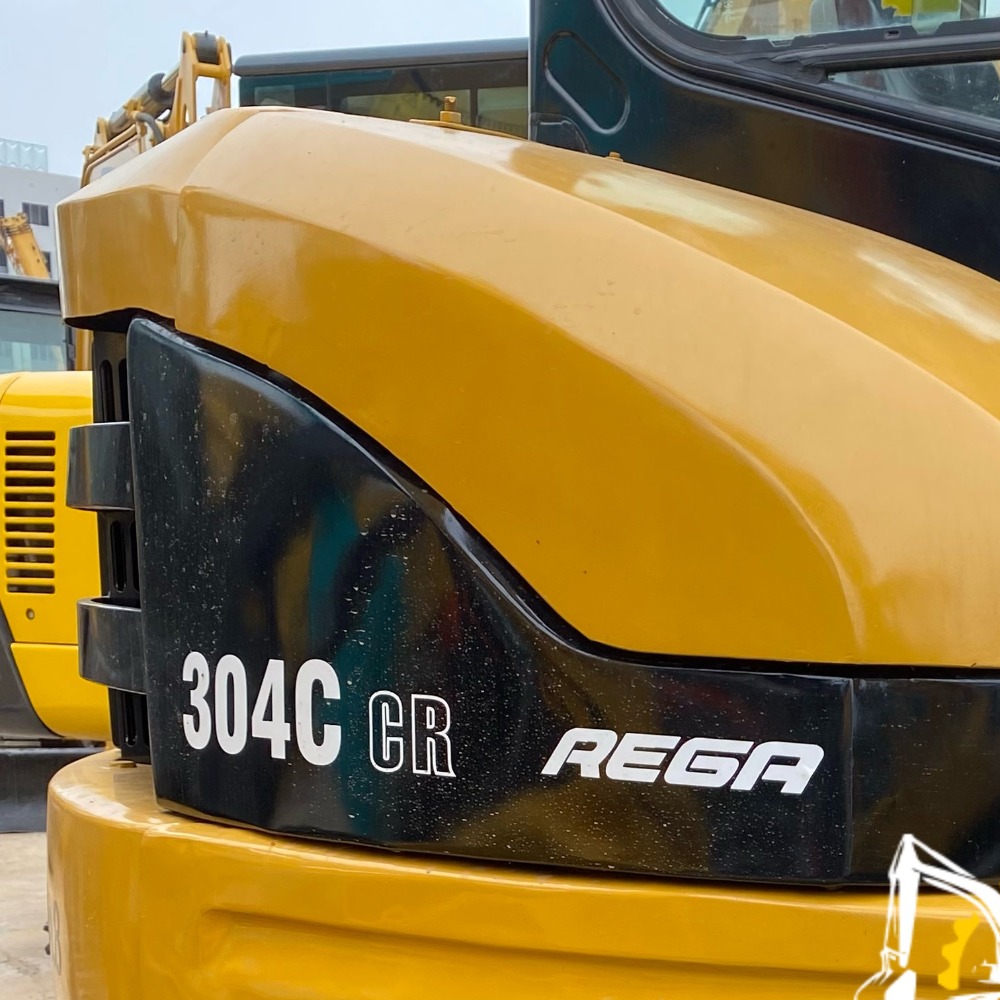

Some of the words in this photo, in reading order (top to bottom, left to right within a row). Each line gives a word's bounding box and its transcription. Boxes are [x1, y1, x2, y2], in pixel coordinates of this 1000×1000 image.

[182, 651, 341, 766] 304C
[368, 690, 456, 777] CR
[541, 727, 824, 795] REGA
